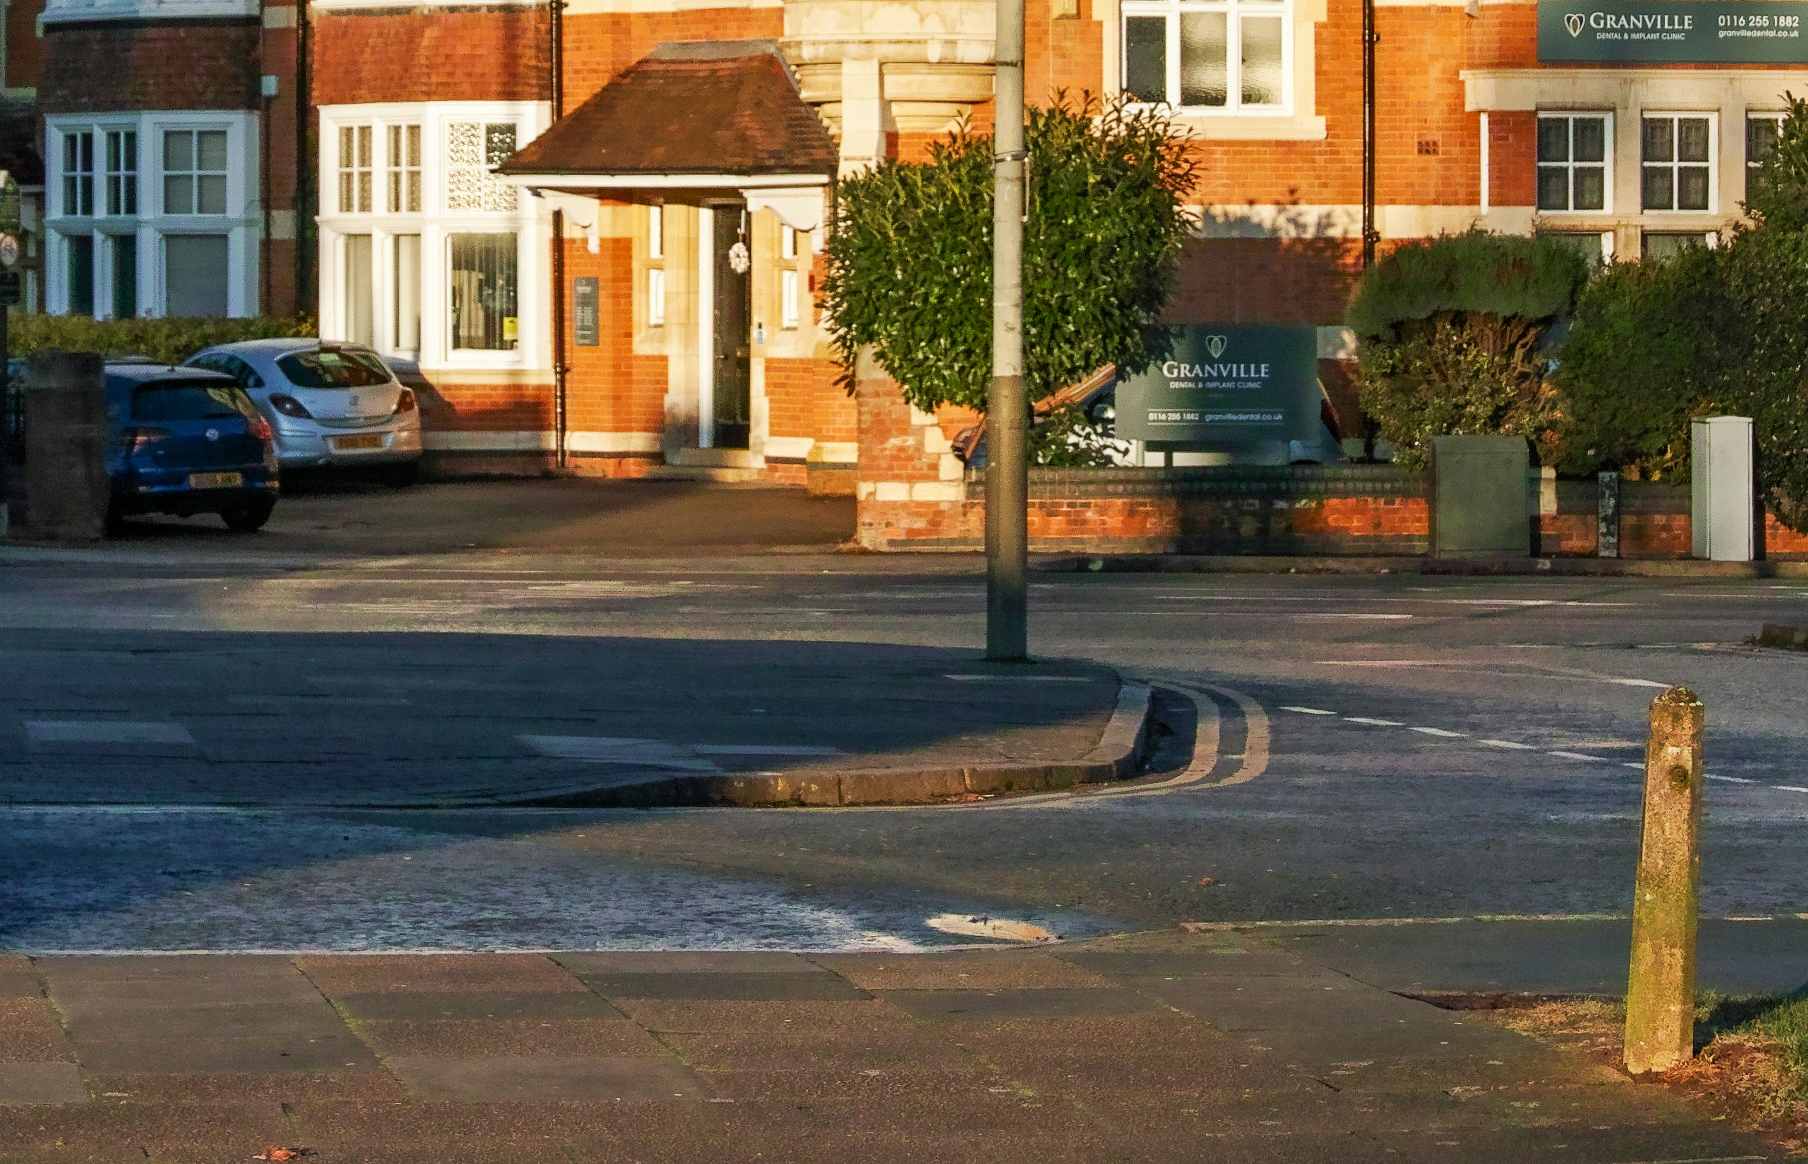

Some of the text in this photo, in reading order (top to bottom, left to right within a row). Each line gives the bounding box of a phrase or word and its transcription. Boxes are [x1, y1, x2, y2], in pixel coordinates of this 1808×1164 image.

[1589, 12, 1693, 30] GRANVILLE
[1718, 15, 1800, 27] 0116 255 1882
[1596, 32, 1622, 40] DENTAL
[1630, 32, 1660, 40] IMPLANT
[1661, 33, 1686, 41] CLINIC
[1718, 29, 1800, 39] granvilledental.co.uk
[1162, 361, 1270, 378] GRANVILLE
[1169, 381, 1196, 389] DENTAL
[1205, 381, 1235, 389] IMPLANT
[1237, 381, 1262, 389] CLINIC
[1148, 413, 1166, 422] 0116
